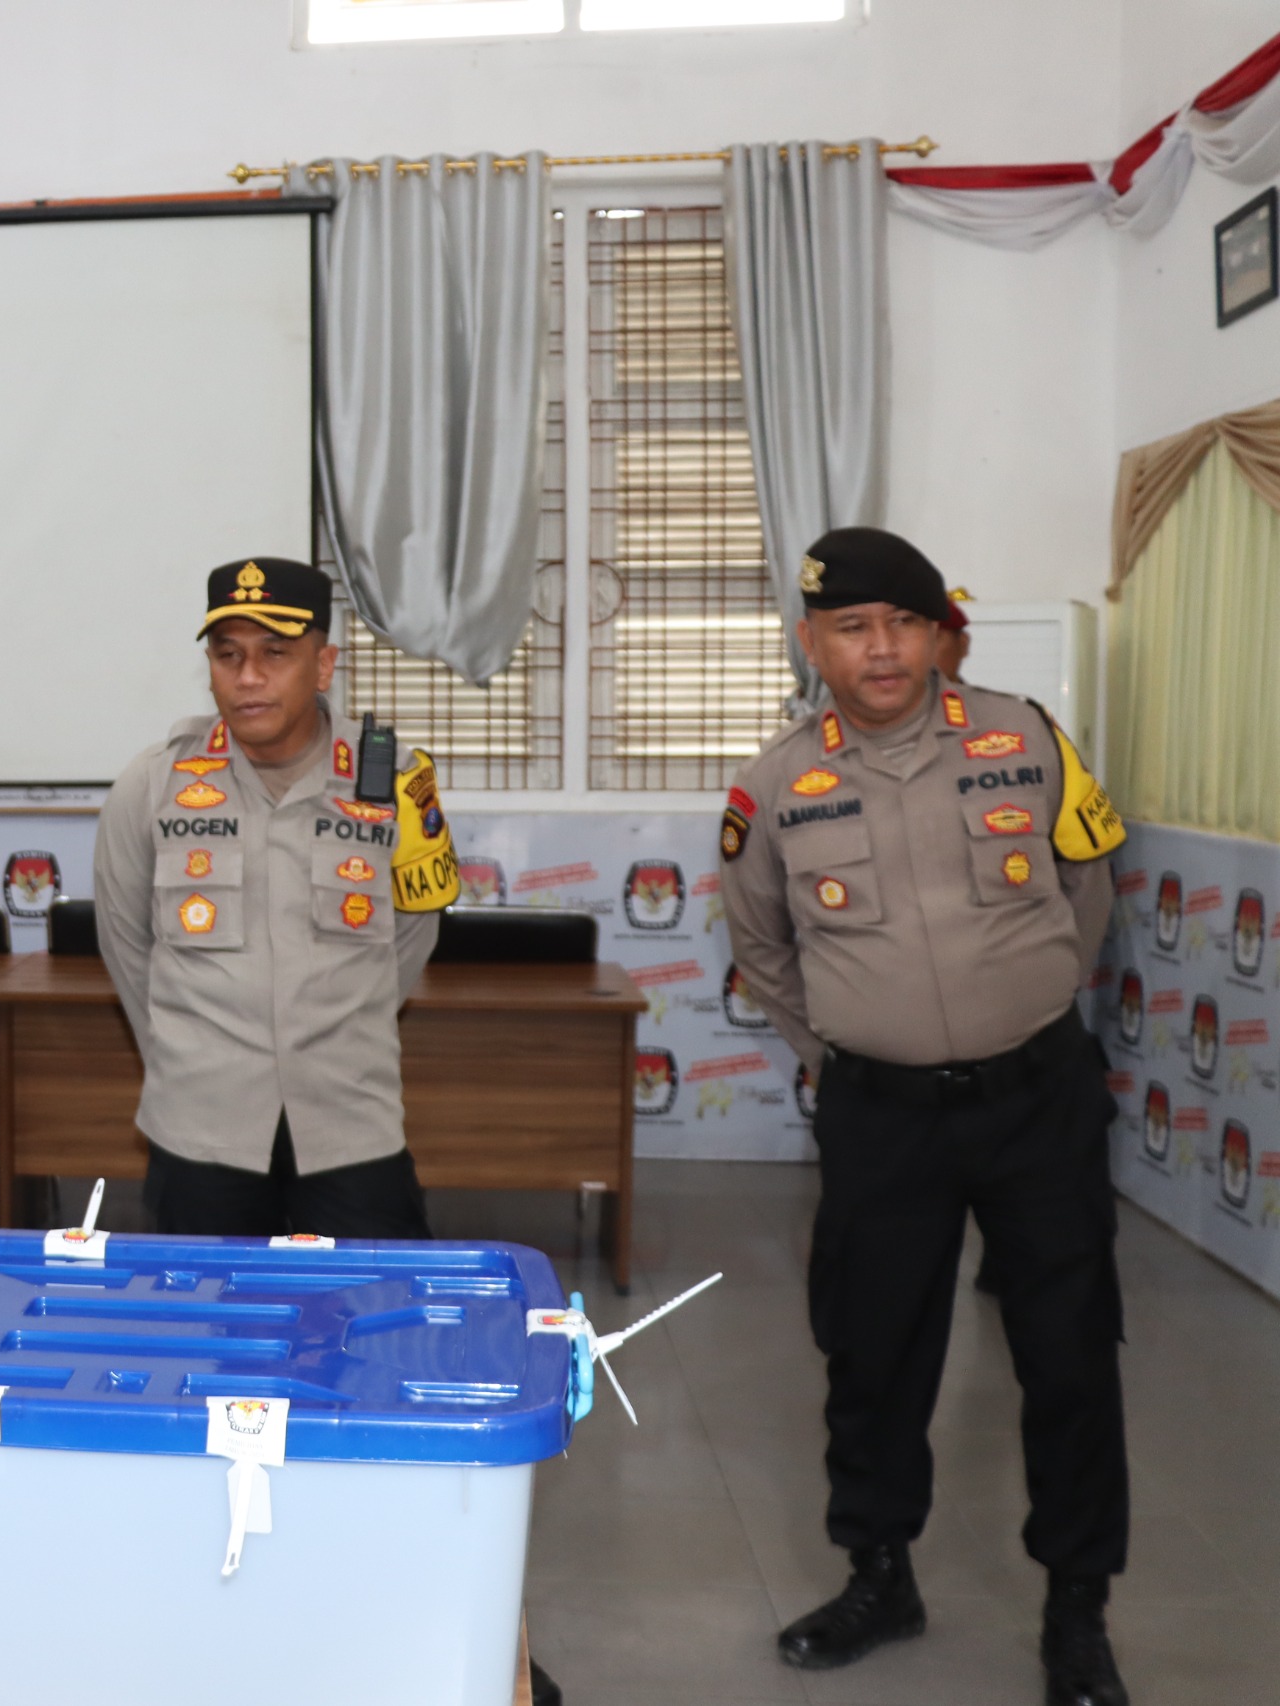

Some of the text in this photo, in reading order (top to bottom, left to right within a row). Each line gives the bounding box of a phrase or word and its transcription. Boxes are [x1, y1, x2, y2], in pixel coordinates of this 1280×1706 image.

[958, 765, 1044, 795] POLRI
[158, 817, 238, 838] YOGEN
[315, 817, 395, 847] POLRI
[402, 864, 433, 901] KA
